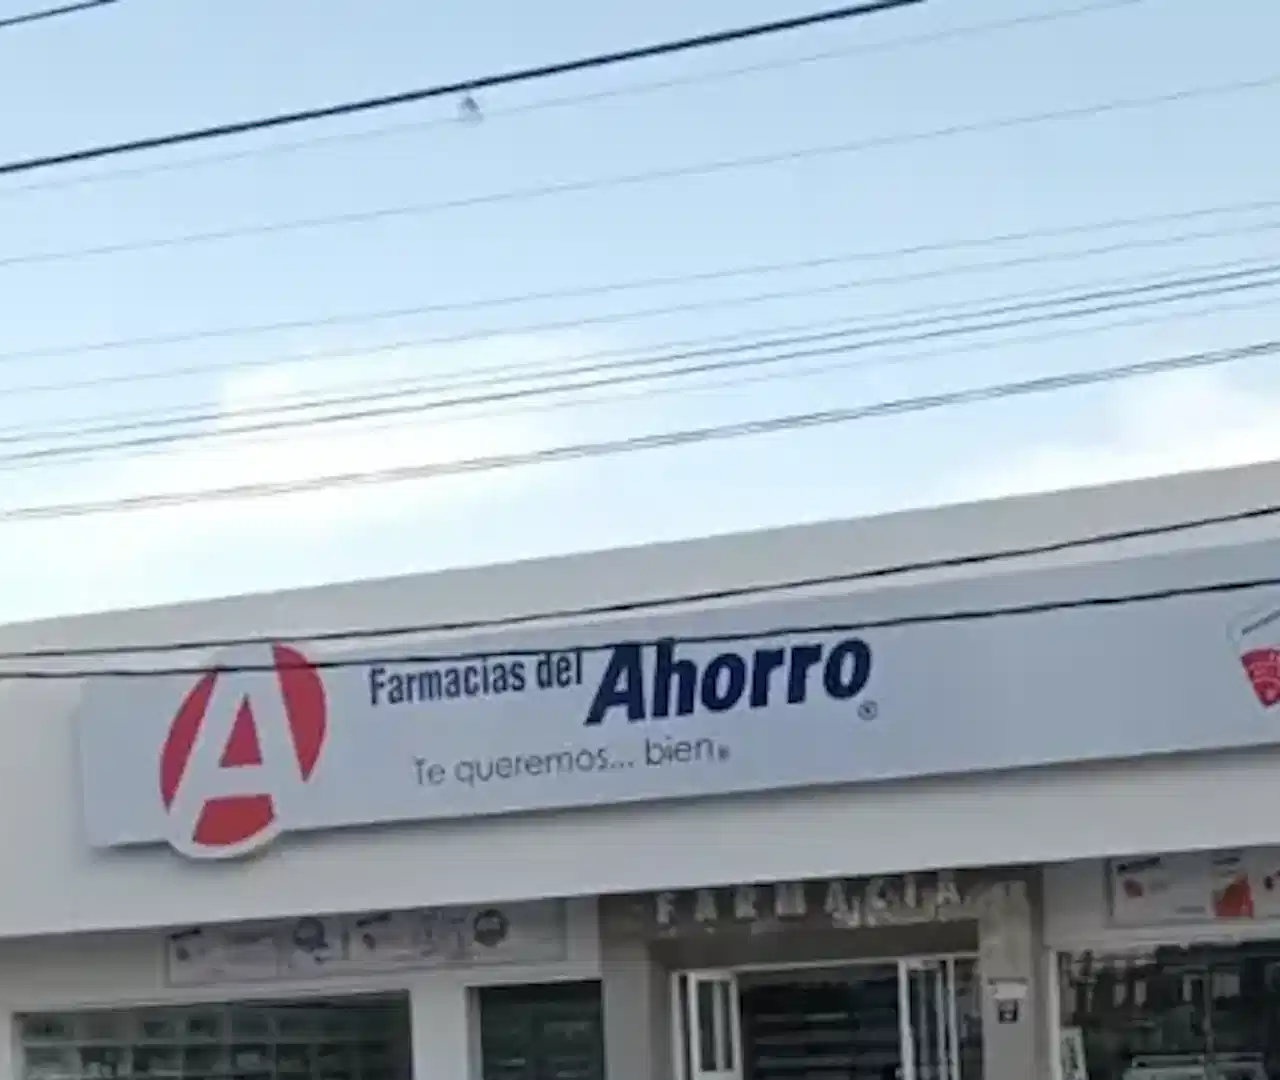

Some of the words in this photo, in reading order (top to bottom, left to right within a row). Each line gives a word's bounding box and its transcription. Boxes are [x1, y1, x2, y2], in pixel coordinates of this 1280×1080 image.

[370, 655, 526, 707] Farmacias
[536, 650, 583, 690] del
[583, 635, 872, 727] Ahorro
[414, 756, 446, 786] Te
[454, 747, 634, 788] queremos...
